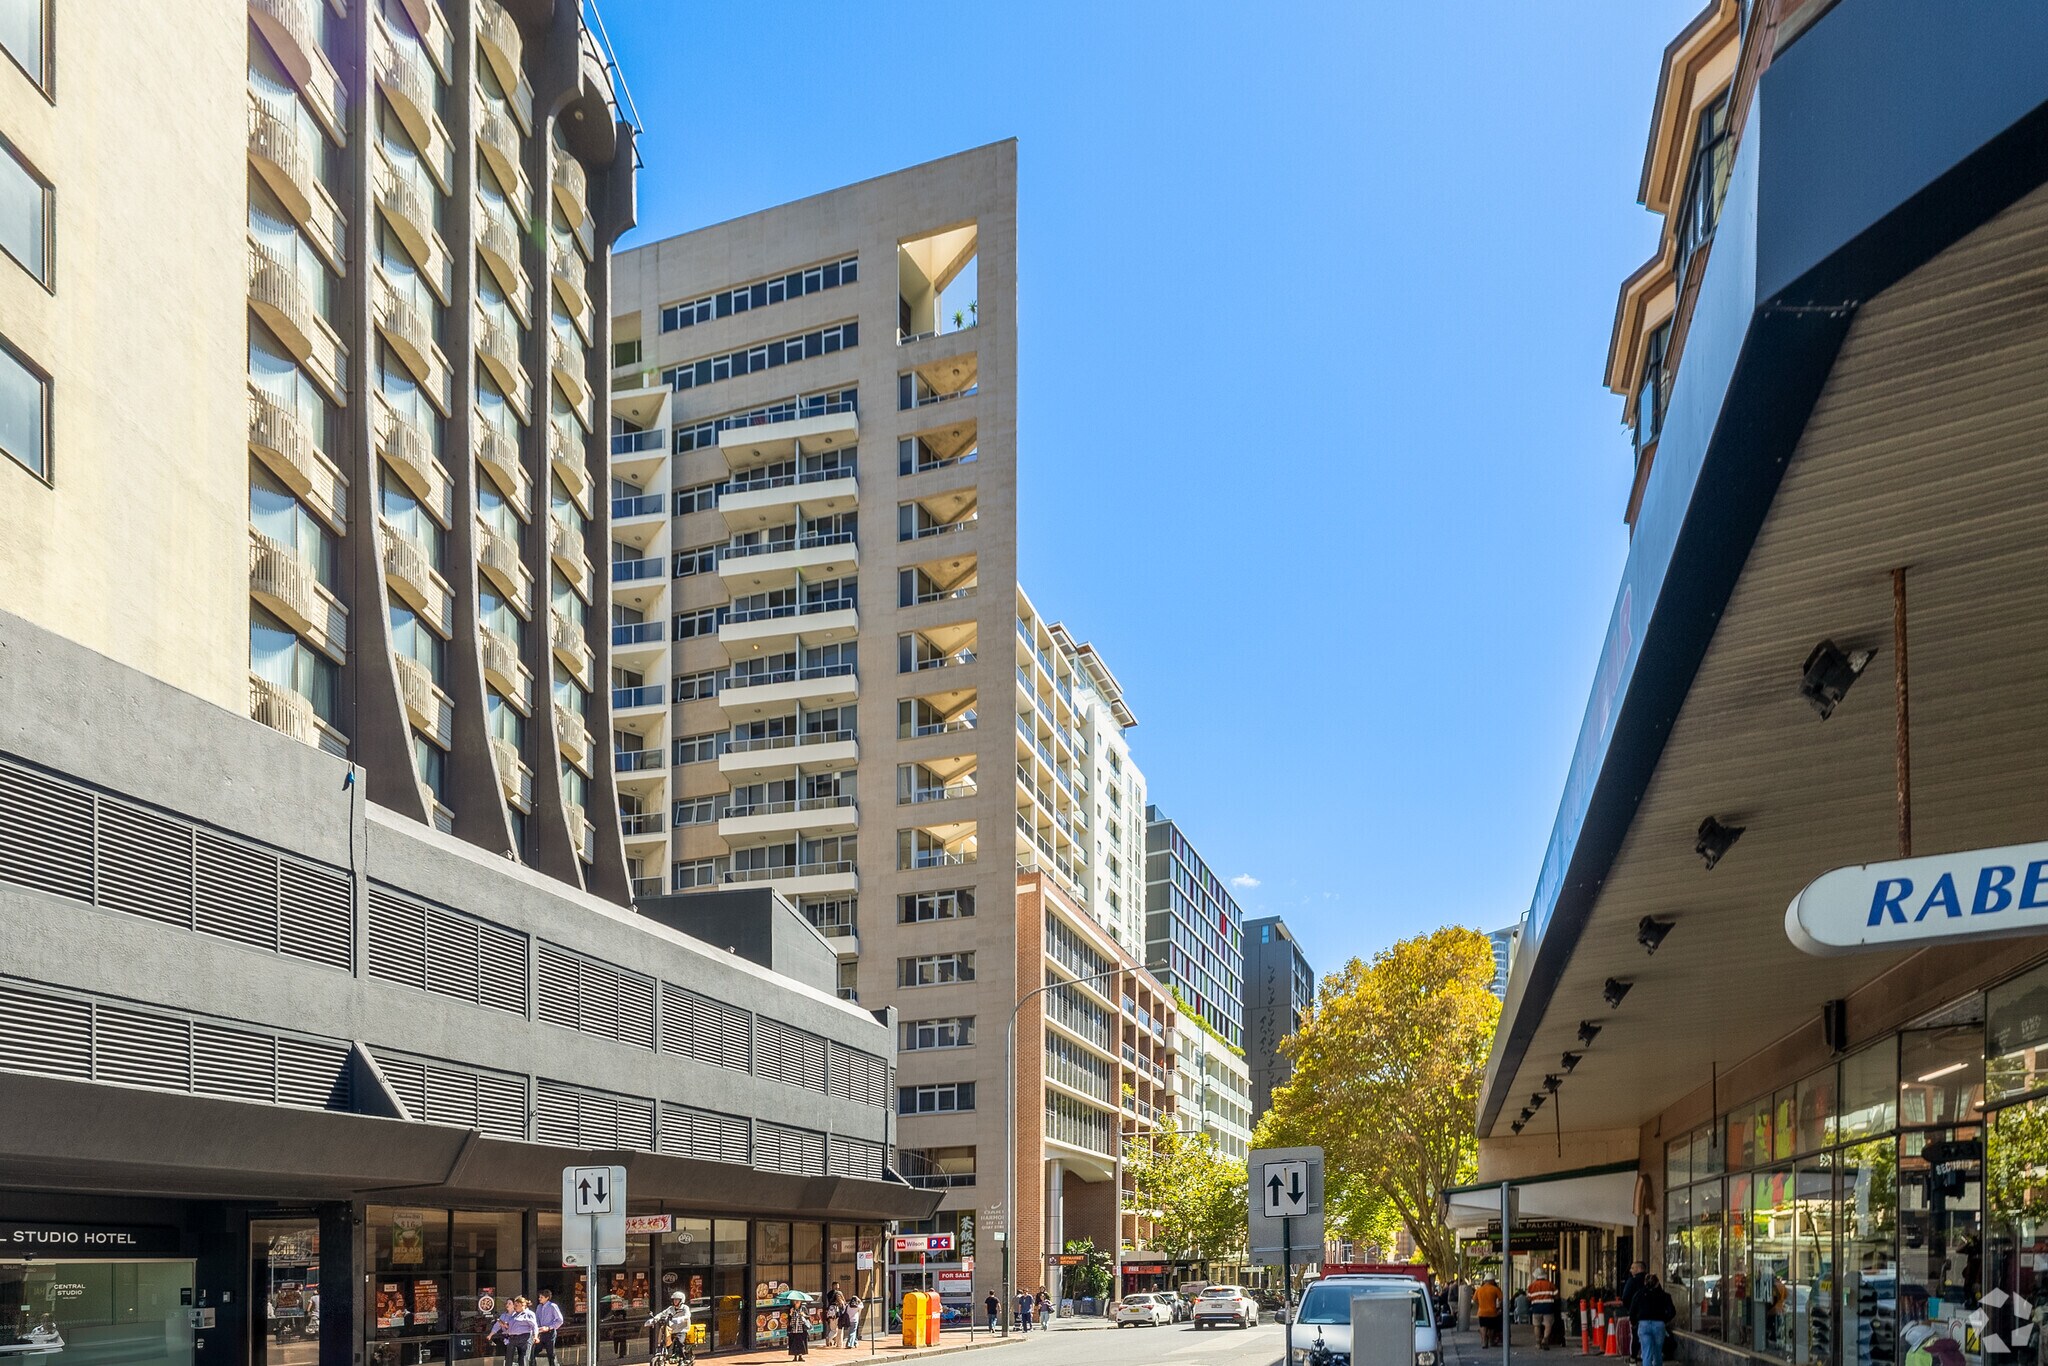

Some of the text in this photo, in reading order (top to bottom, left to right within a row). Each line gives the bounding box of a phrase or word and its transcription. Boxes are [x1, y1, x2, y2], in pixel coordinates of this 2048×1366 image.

[1526, 1221, 1558, 1229] PALACE
[13, 1230, 137, 1244] STUDIO HOTEL
[931, 1239, 938, 1247] P
